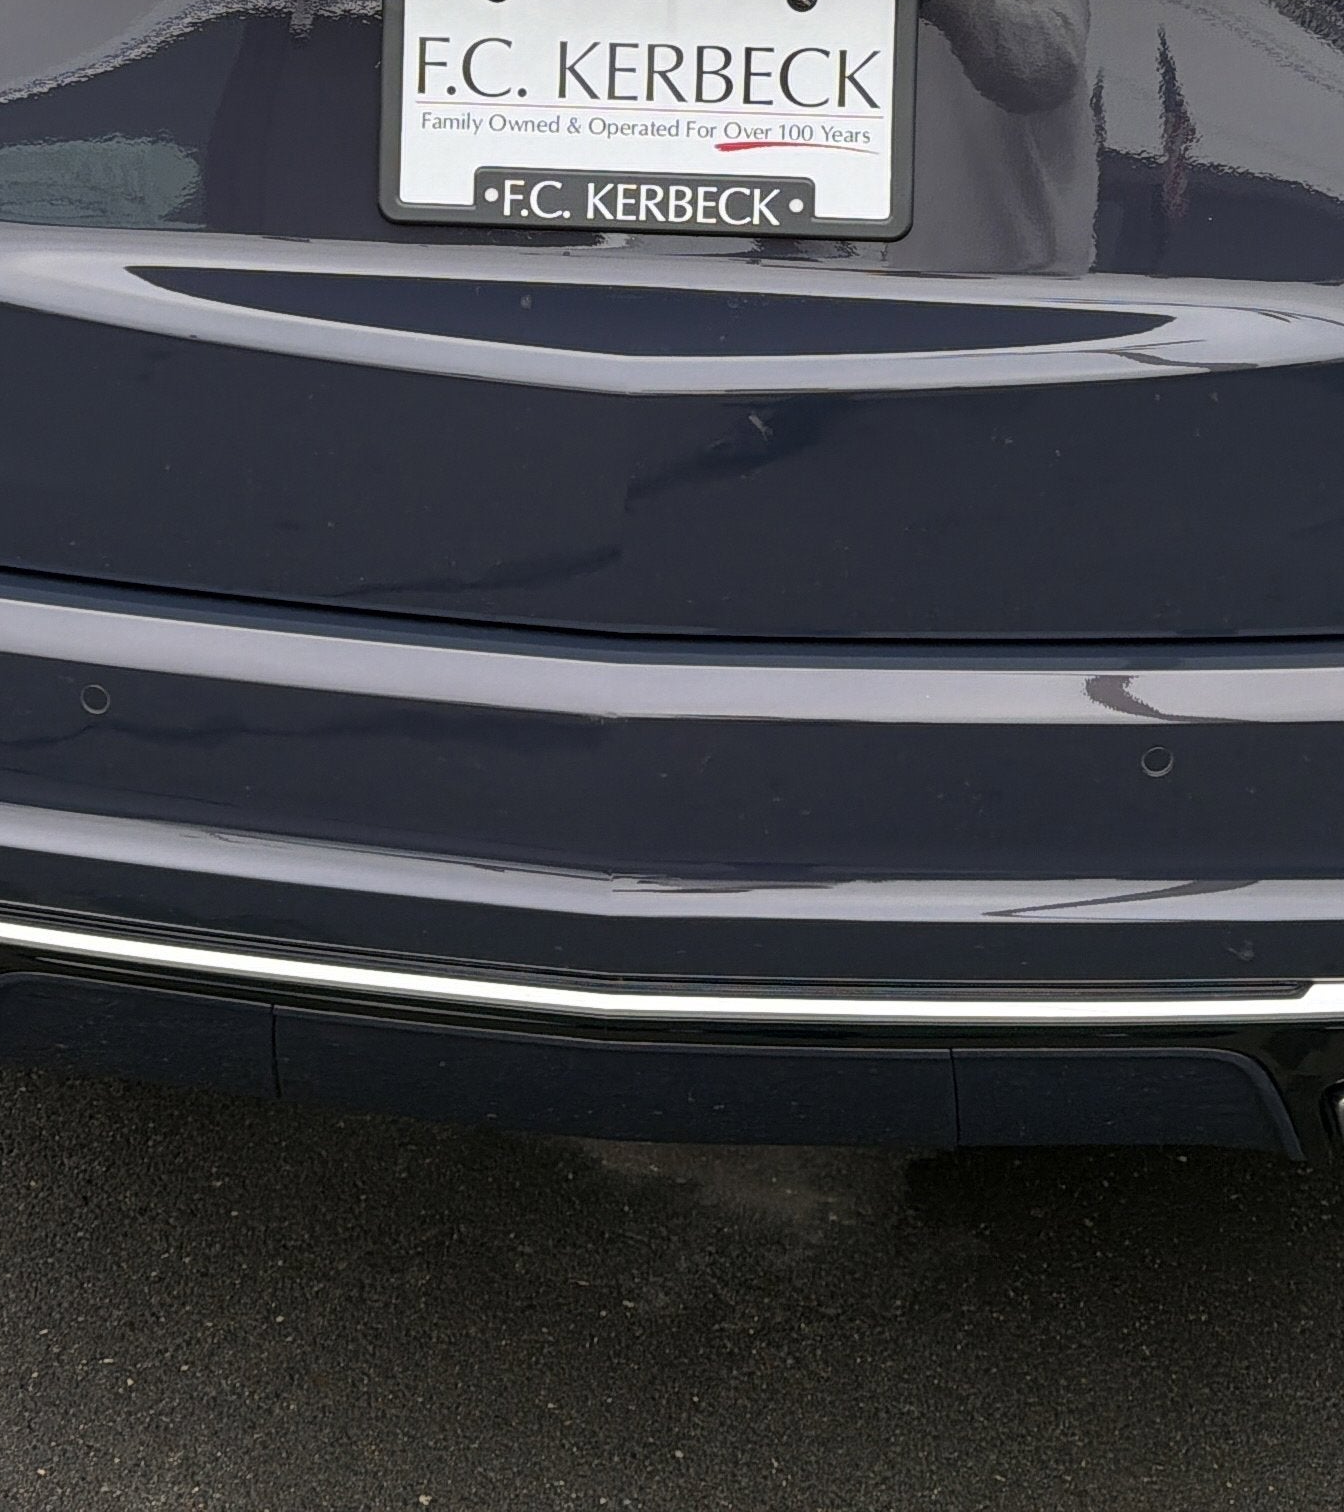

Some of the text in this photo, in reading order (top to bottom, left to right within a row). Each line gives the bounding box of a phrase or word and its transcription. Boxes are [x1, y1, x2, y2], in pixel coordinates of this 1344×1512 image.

[416, 36, 881, 110] F.C. KERBECK
[421, 111, 871, 145] Family Owned & Operated For Over 100 Years
[502, 180, 781, 227] F.C. KERBECK
